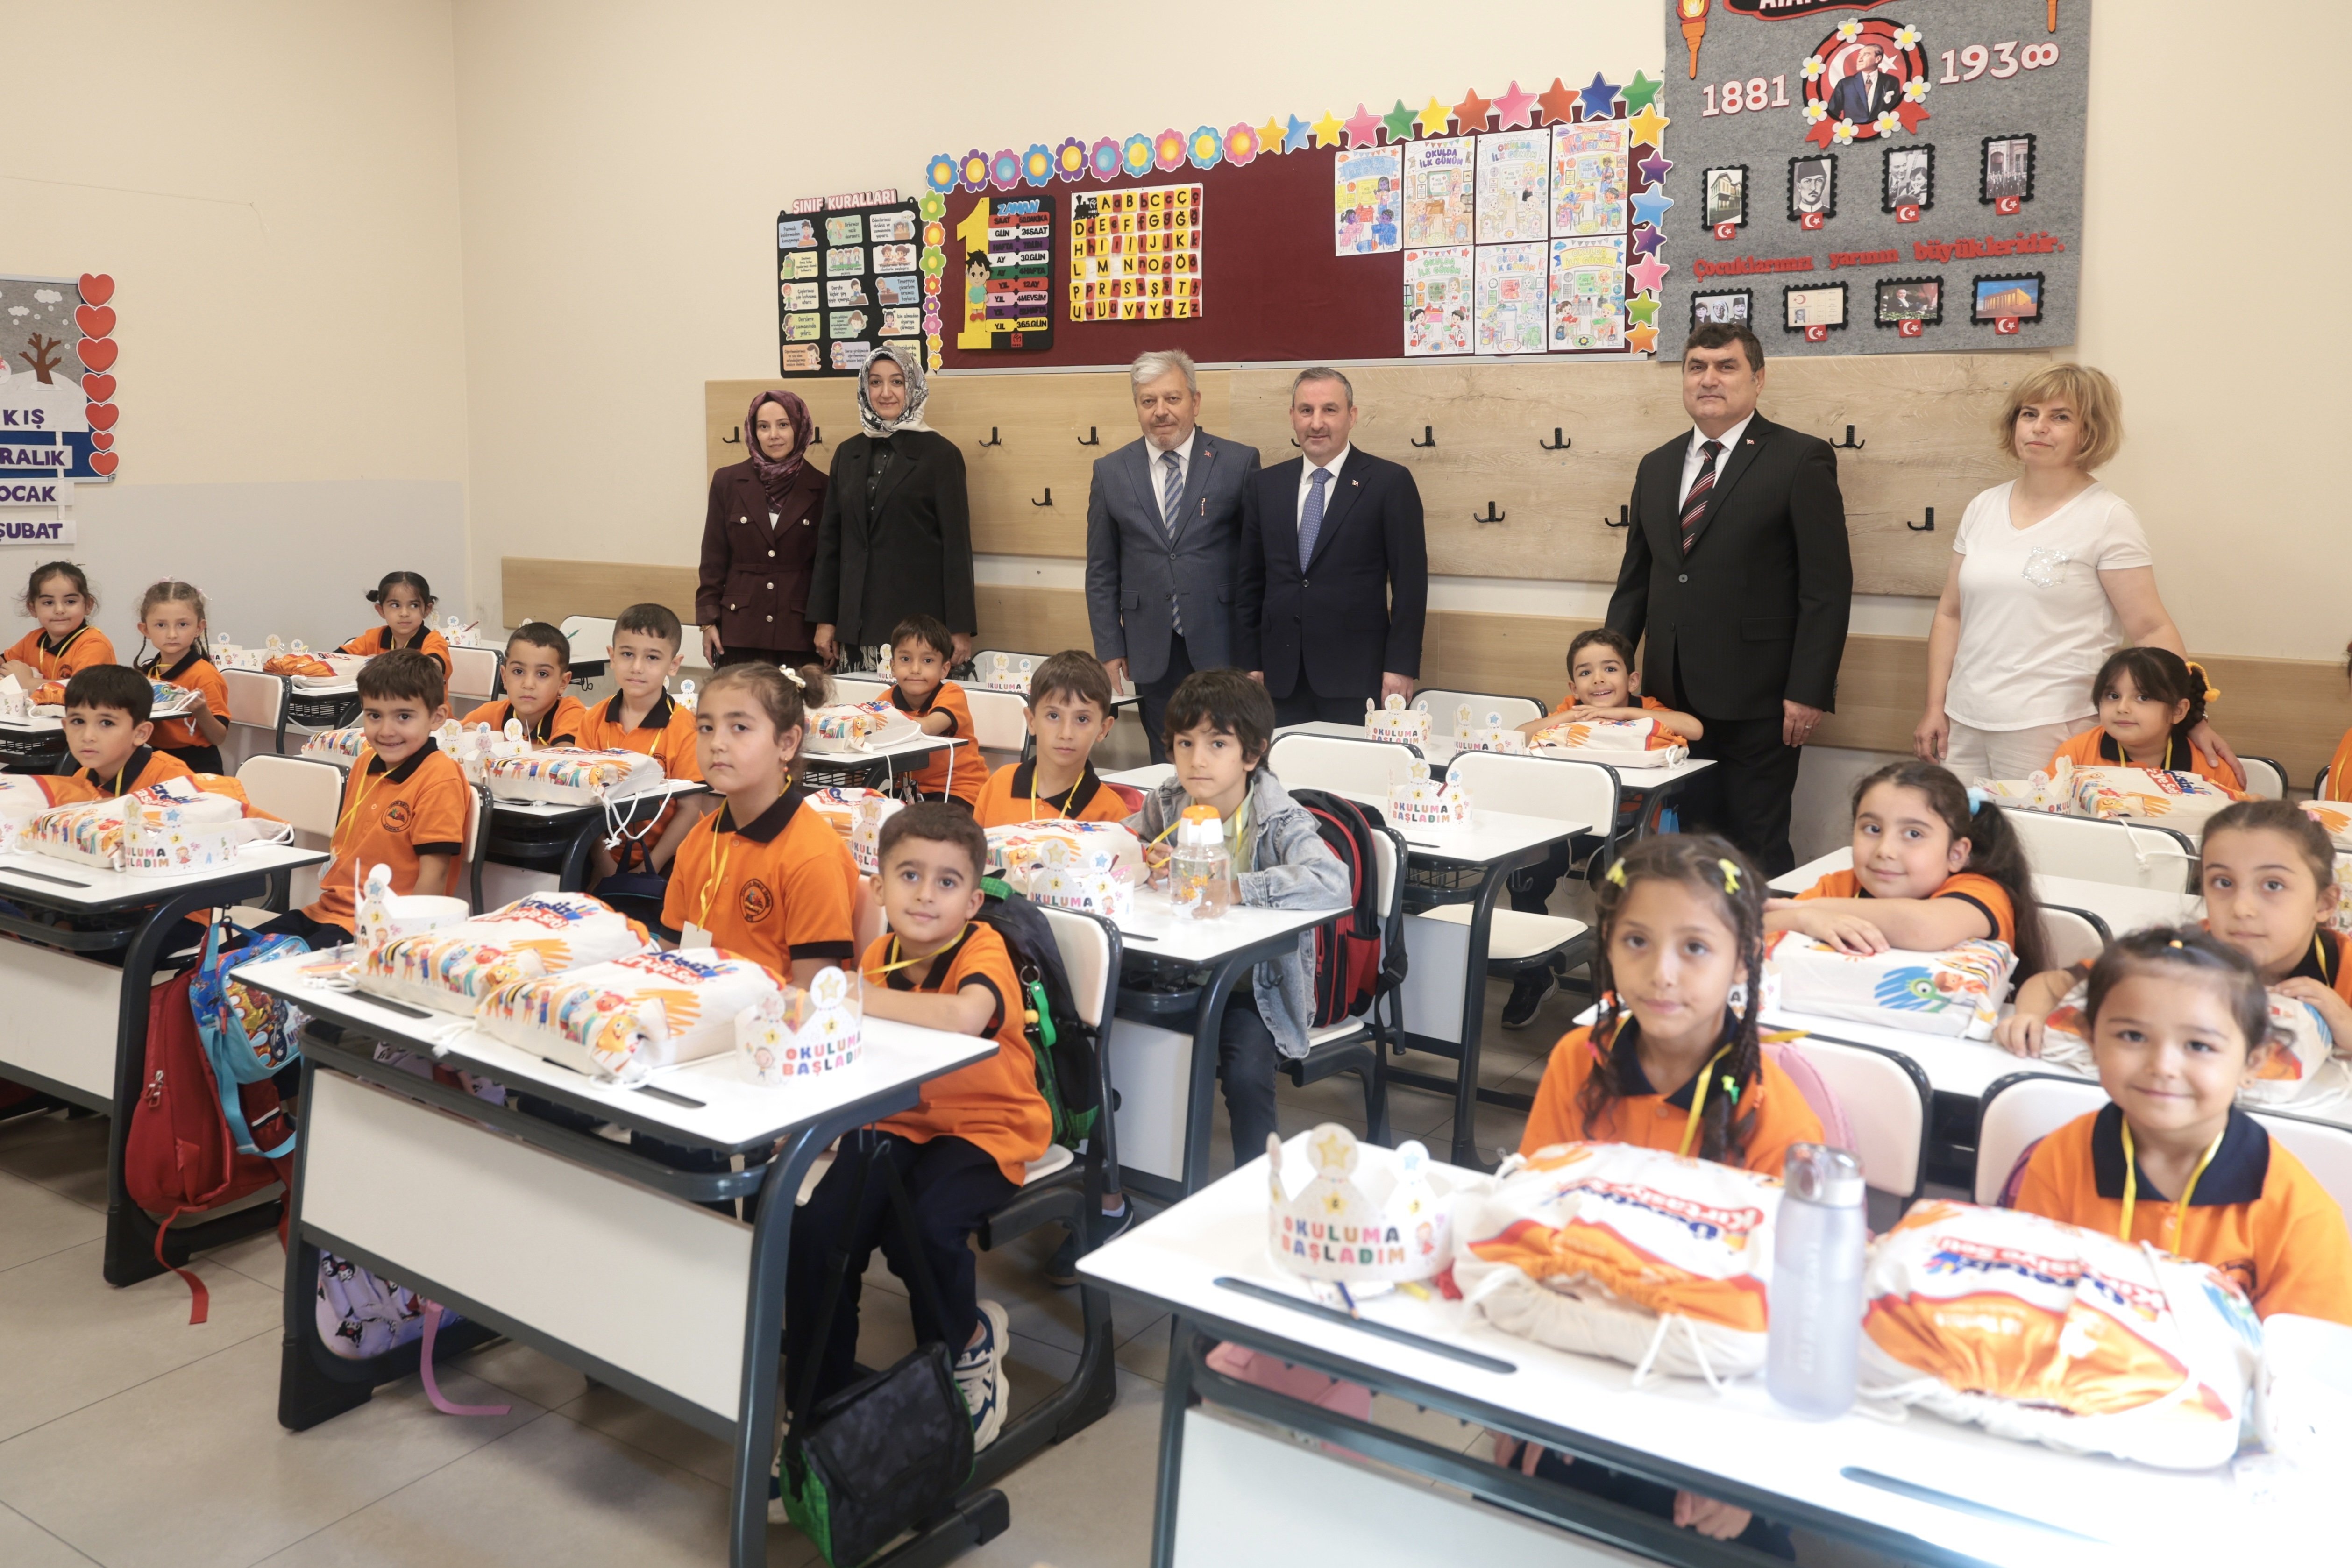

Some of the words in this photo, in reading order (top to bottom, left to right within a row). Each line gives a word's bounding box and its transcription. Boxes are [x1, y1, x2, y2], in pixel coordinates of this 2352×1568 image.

[1702, 74, 1791, 117] 1881
[1426, 149, 1457, 158] OKULDA
[793, 198, 824, 215] SINIF
[828, 189, 897, 210] KURALLARI
[997, 199, 1040, 216] ZAMAN
[1102, 197, 1110, 209] A
[1127, 195, 1133, 207] B
[1151, 194, 1159, 206] C
[1177, 191, 1187, 205] Ç
[1075, 222, 1084, 235] D
[1100, 219, 1105, 231] E
[1124, 219, 1130, 231] F
[1149, 214, 1159, 227] G
[1176, 211, 1186, 226] Ğ
[1075, 244, 1083, 256] H
[1150, 235, 1156, 248] J
[1177, 234, 1184, 247] K
[1074, 264, 1081, 276] L
[1098, 260, 1108, 272] M
[1124, 258, 1132, 271] N
[1149, 259, 1159, 271] O
[1176, 254, 1185, 269] Ö
[1693, 256, 1814, 282] Çocuklarımız
[1828, 249, 1899, 270] yarının
[1913, 231, 2065, 263] büyükleridir.
[1073, 286, 1079, 299] P
[1100, 283, 1105, 295] R
[1124, 282, 1131, 294] S
[1151, 282, 1158, 297] Ş
[1179, 281, 1186, 294] T
[1073, 305, 1080, 318] U
[1124, 304, 1133, 316] V
[1150, 303, 1158, 316] Y
[1179, 302, 1186, 315] Z
[4, 409, 45, 429] KIŞ
[0, 485, 56, 503] OCAK
[1373, 728, 1418, 737] OKULUMA
[1393, 810, 1450, 823] BAŞLADIM
[1394, 802, 1448, 814] OKULUMA
[1284, 1216, 1400, 1244] OKULUMA
[1282, 1234, 1406, 1265] BAŞLADIM
